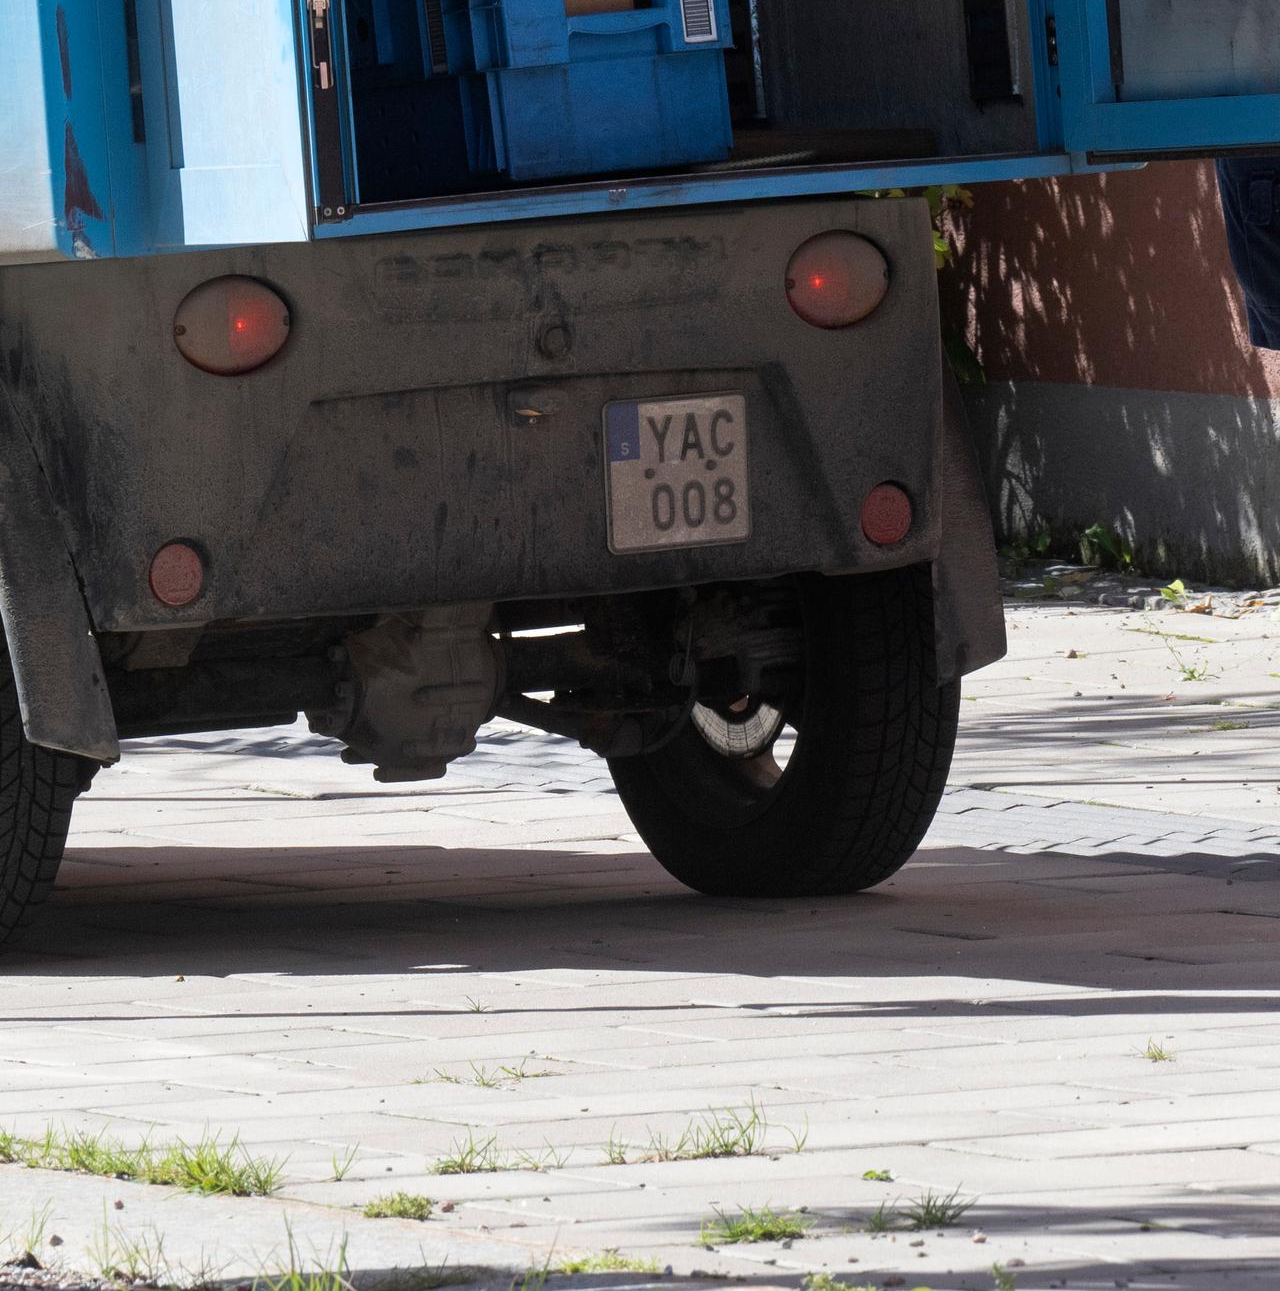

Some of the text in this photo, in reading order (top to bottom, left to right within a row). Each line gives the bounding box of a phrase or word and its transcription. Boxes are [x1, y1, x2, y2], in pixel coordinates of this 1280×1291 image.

[621, 409, 734, 463] S YAC
[652, 477, 737, 531] 008
